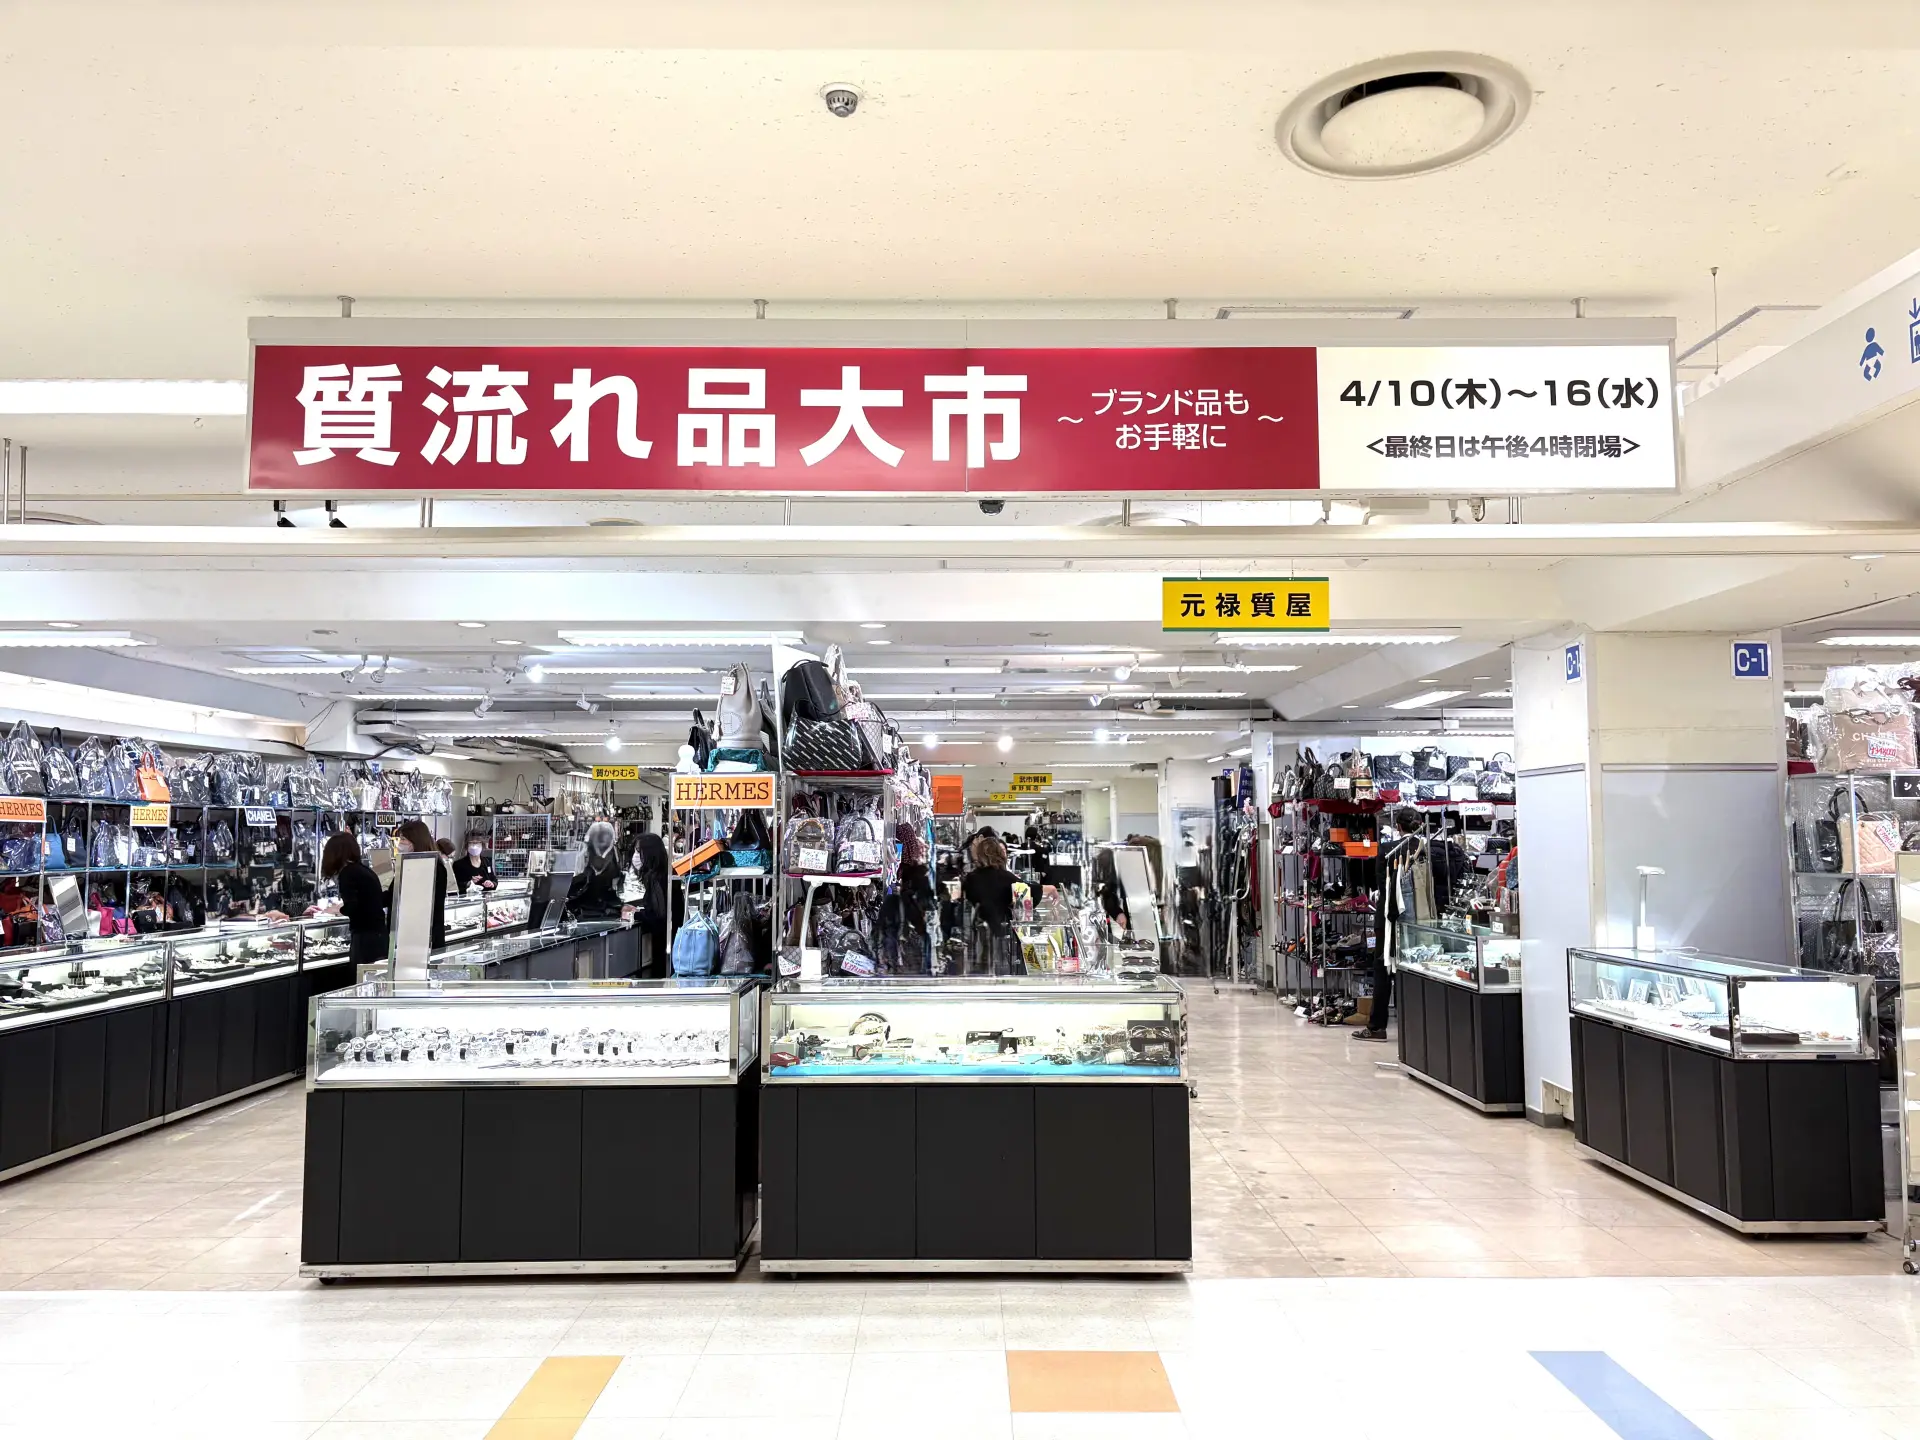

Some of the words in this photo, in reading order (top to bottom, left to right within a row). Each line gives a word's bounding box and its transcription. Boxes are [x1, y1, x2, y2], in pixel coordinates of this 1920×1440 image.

[1091, 388, 1250, 416] ブランド品も
[293, 363, 1029, 468] 質流れ品大市
[1115, 422, 1227, 451] お手軽に
[1180, 592, 1312, 618] 元禄質屋
[1737, 648, 1765, 672] C-1
[676, 781, 769, 801] HERMES
[0, 802, 43, 817] HERMES
[132, 808, 168, 821] HERMES
[247, 810, 276, 823] CHANEL
[377, 813, 395, 824] GUCCI
